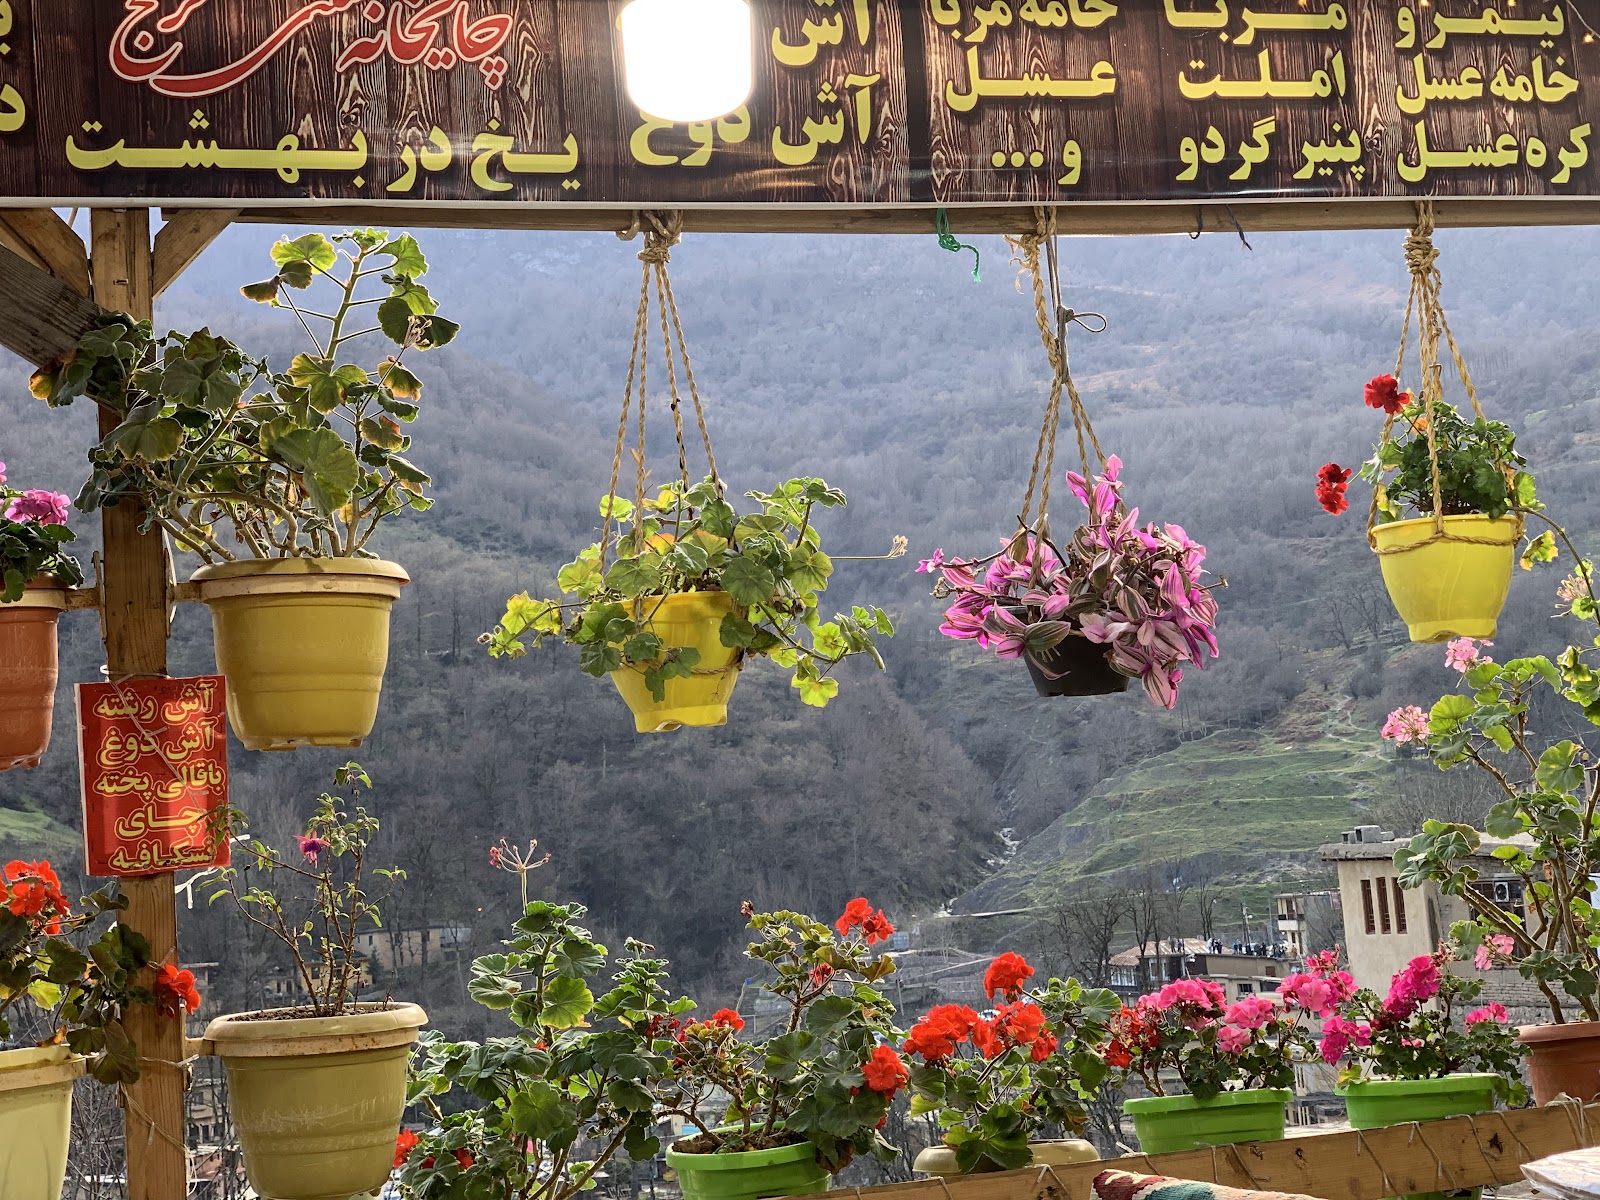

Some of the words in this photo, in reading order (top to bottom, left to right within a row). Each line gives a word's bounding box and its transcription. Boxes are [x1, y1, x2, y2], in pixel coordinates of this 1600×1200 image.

[945, 45, 1117, 112] عسل
[1178, 48, 1347, 99] املت
[1396, 53, 1484, 115] عسل
[1490, 54, 1580, 103] خامه
[65, 109, 368, 188] بهشت
[771, 73, 881, 166] آش
[1175, 115, 1276, 182] گردو
[386, 126, 453, 192] در
[469, 118, 580, 192] یخ
[1292, 122, 1366, 181] پنیر
[1397, 119, 1519, 183] عسل
[1525, 122, 1592, 184] کره
[96, 690, 155, 720] رشته
[163, 681, 215, 722] آش
[99, 729, 158, 766] دوغ
[165, 720, 216, 760] آش
[96, 769, 150, 801] پخته
[156, 762, 223, 798] باقالی
[118, 804, 204, 837] چای
